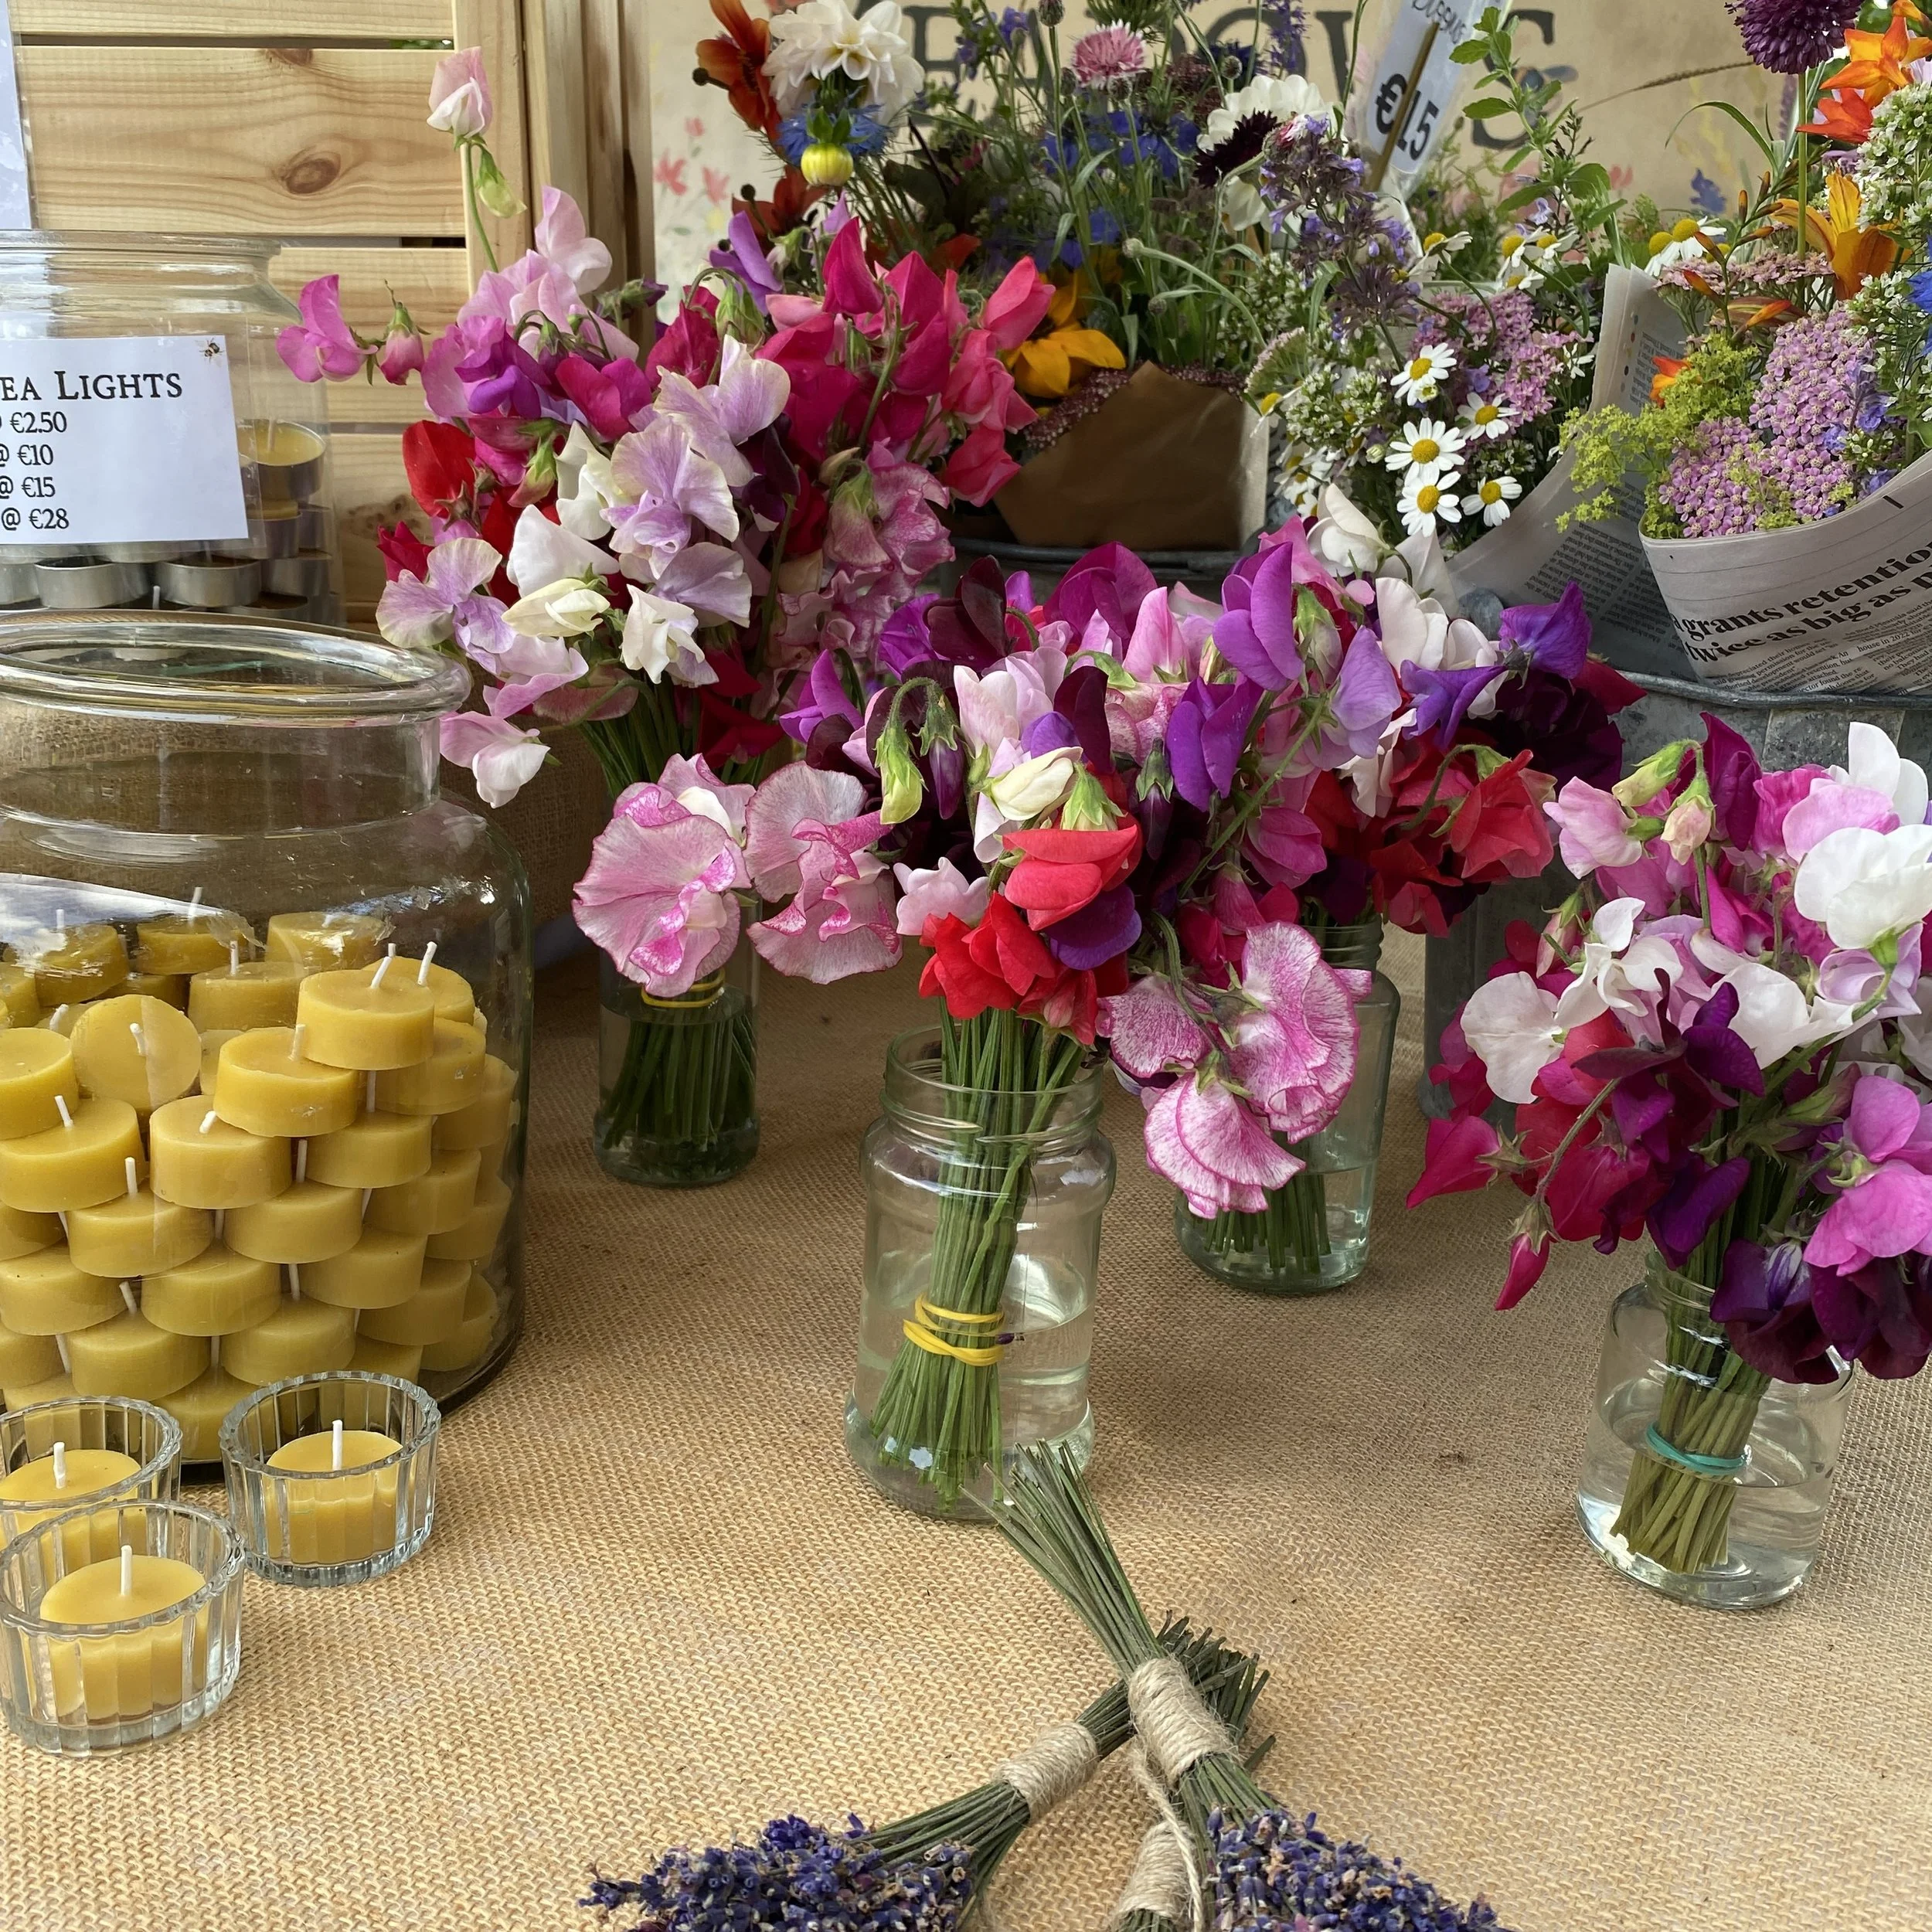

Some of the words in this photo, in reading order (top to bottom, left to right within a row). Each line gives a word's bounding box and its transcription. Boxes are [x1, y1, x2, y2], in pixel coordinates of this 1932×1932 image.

[54, 370, 183, 400] LIGHTS
[10, 411, 67, 433] €2.50
[17, 444, 54, 465] €10
[21, 476, 56, 498] €15
[2, 507, 21, 531] @
[29, 508, 70, 529] €28
[1682, 607, 1784, 642] grants
[1782, 542, 1932, 615] retentio
[1685, 639, 1767, 663] twice
[1766, 626, 1808, 642] as
[1801, 602, 1872, 631] big
[1868, 586, 1912, 608] as
[1857, 642, 1881, 652] house
[1880, 638, 1890, 646] in
[1890, 631, 1911, 644] 2022
[1818, 675, 1840, 686] found
[1840, 671, 1853, 680] the
